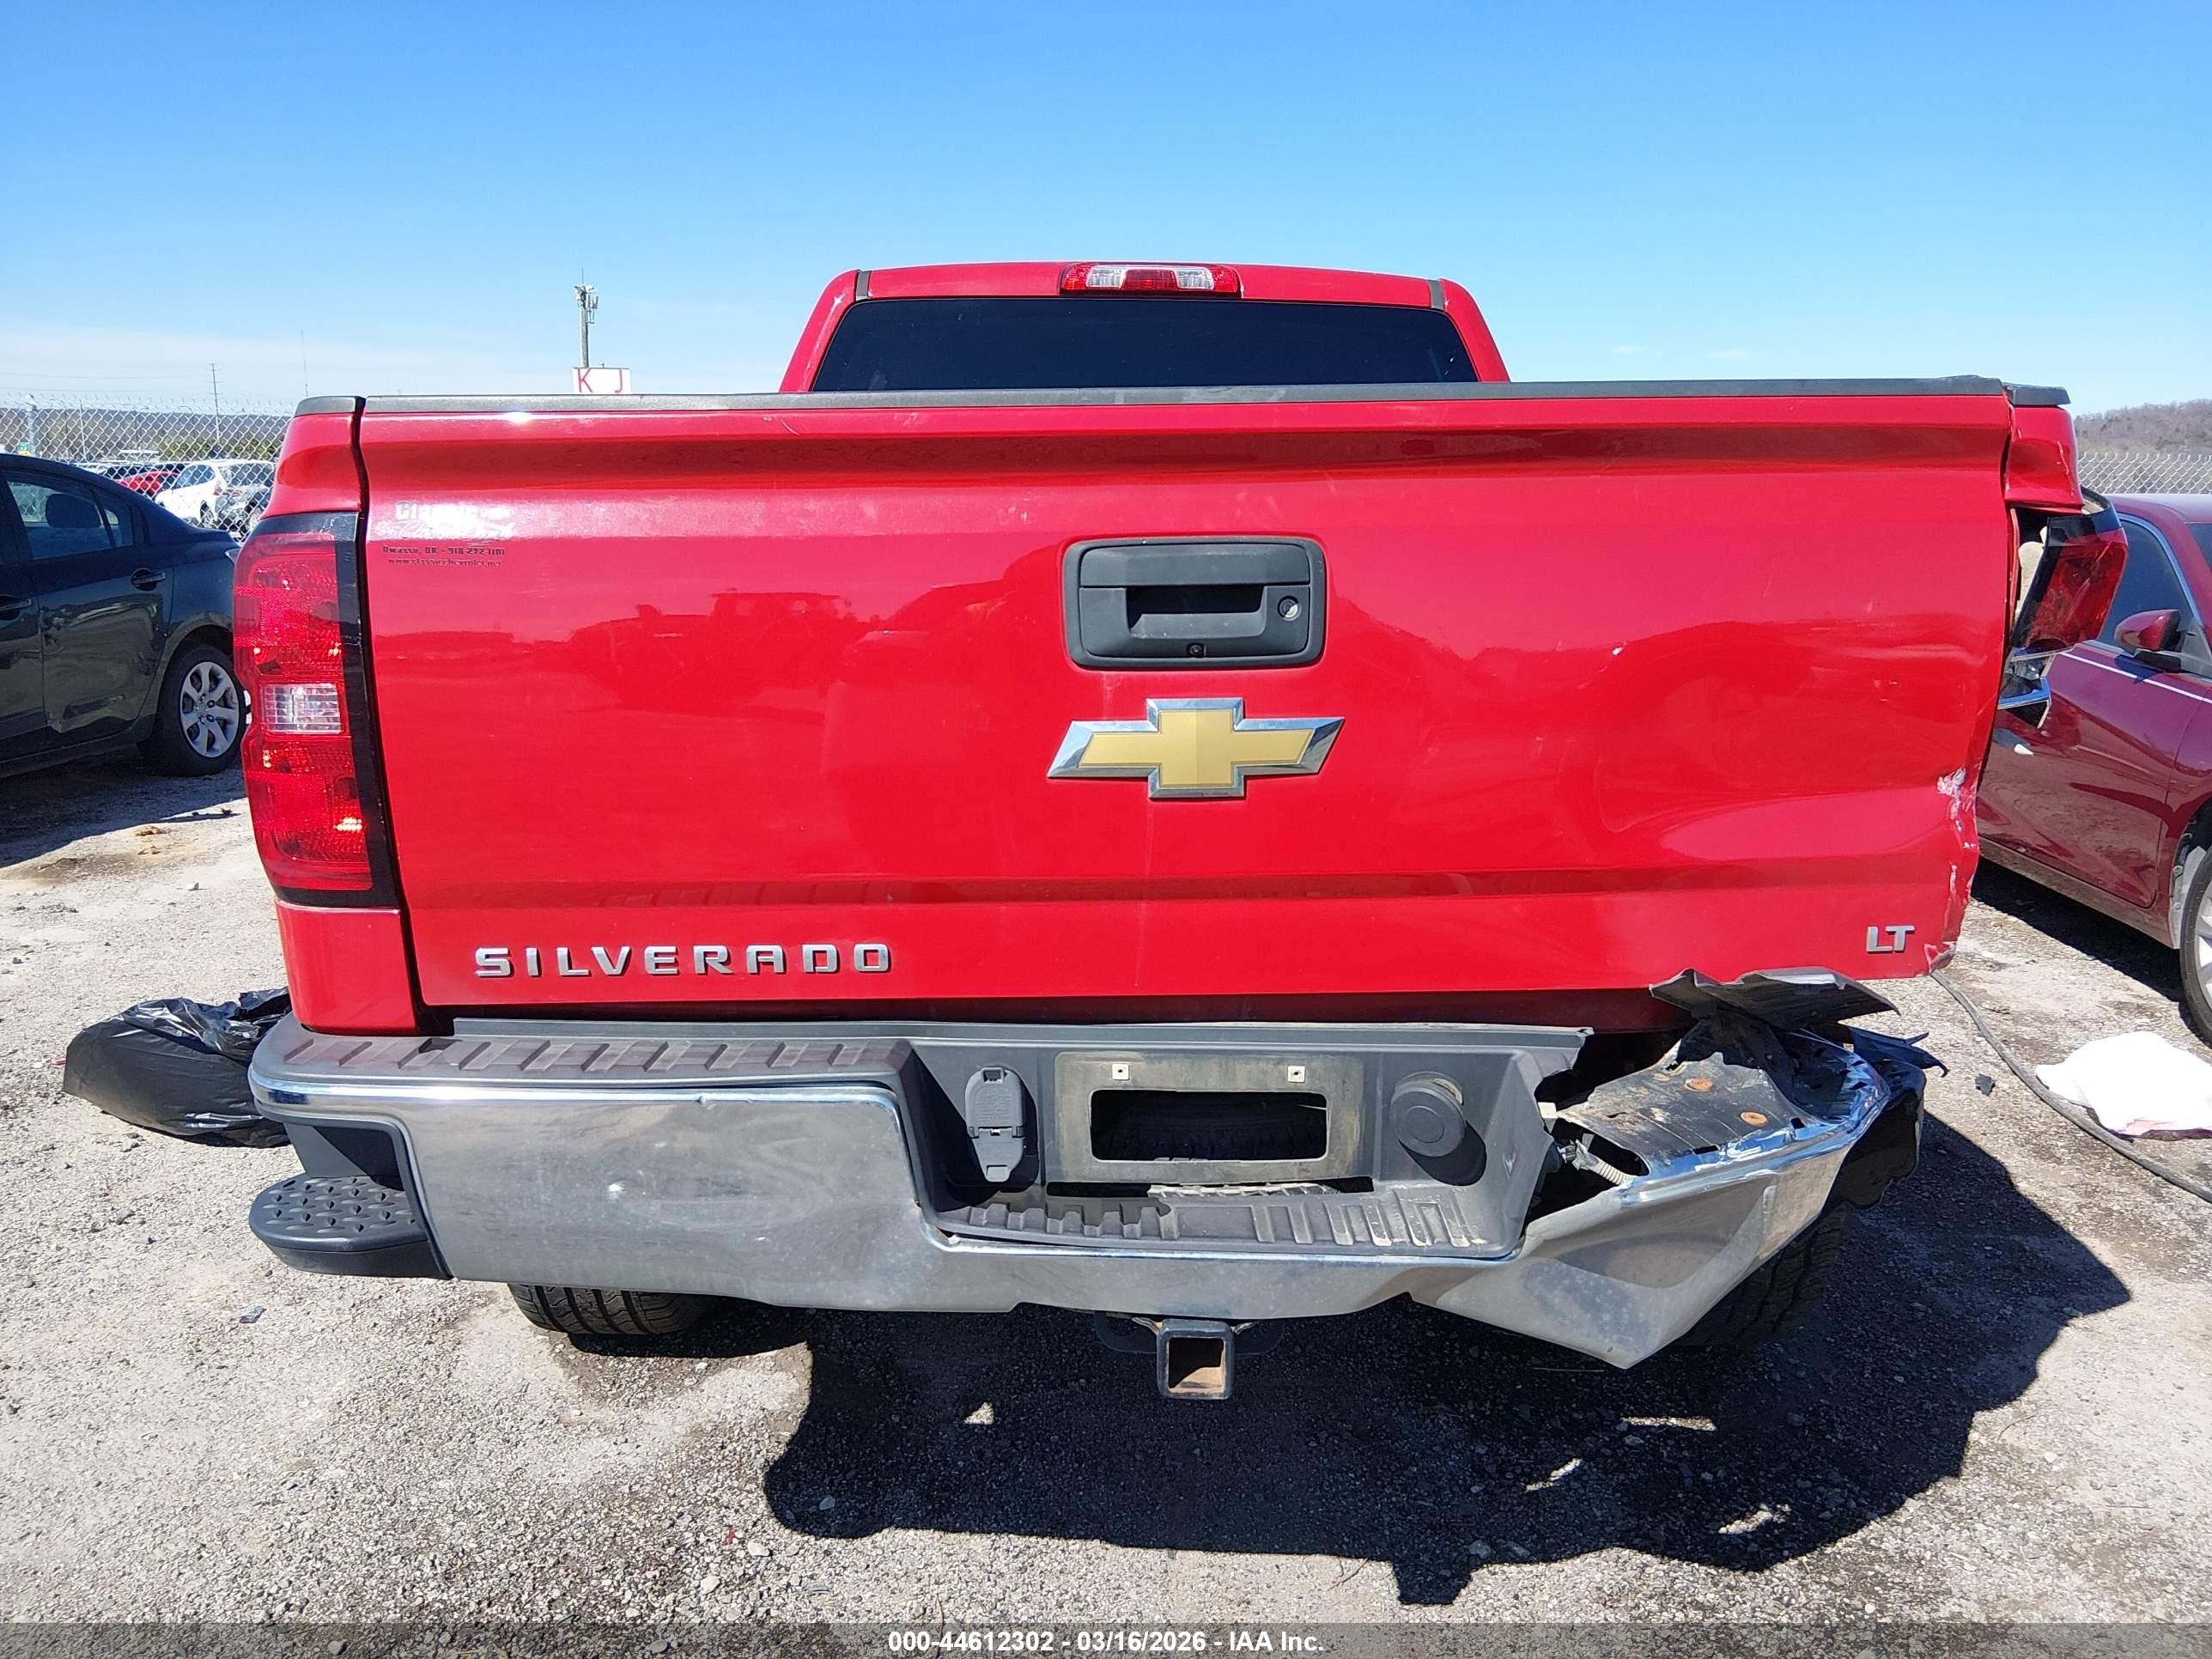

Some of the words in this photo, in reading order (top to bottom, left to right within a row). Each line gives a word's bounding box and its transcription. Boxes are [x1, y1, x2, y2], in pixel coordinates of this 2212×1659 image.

[577, 368, 594, 393] K
[614, 368, 623, 393] J
[425, 546, 439, 555] OK
[1866, 925, 1915, 952] LT
[475, 943, 892, 976] SILVERADO
